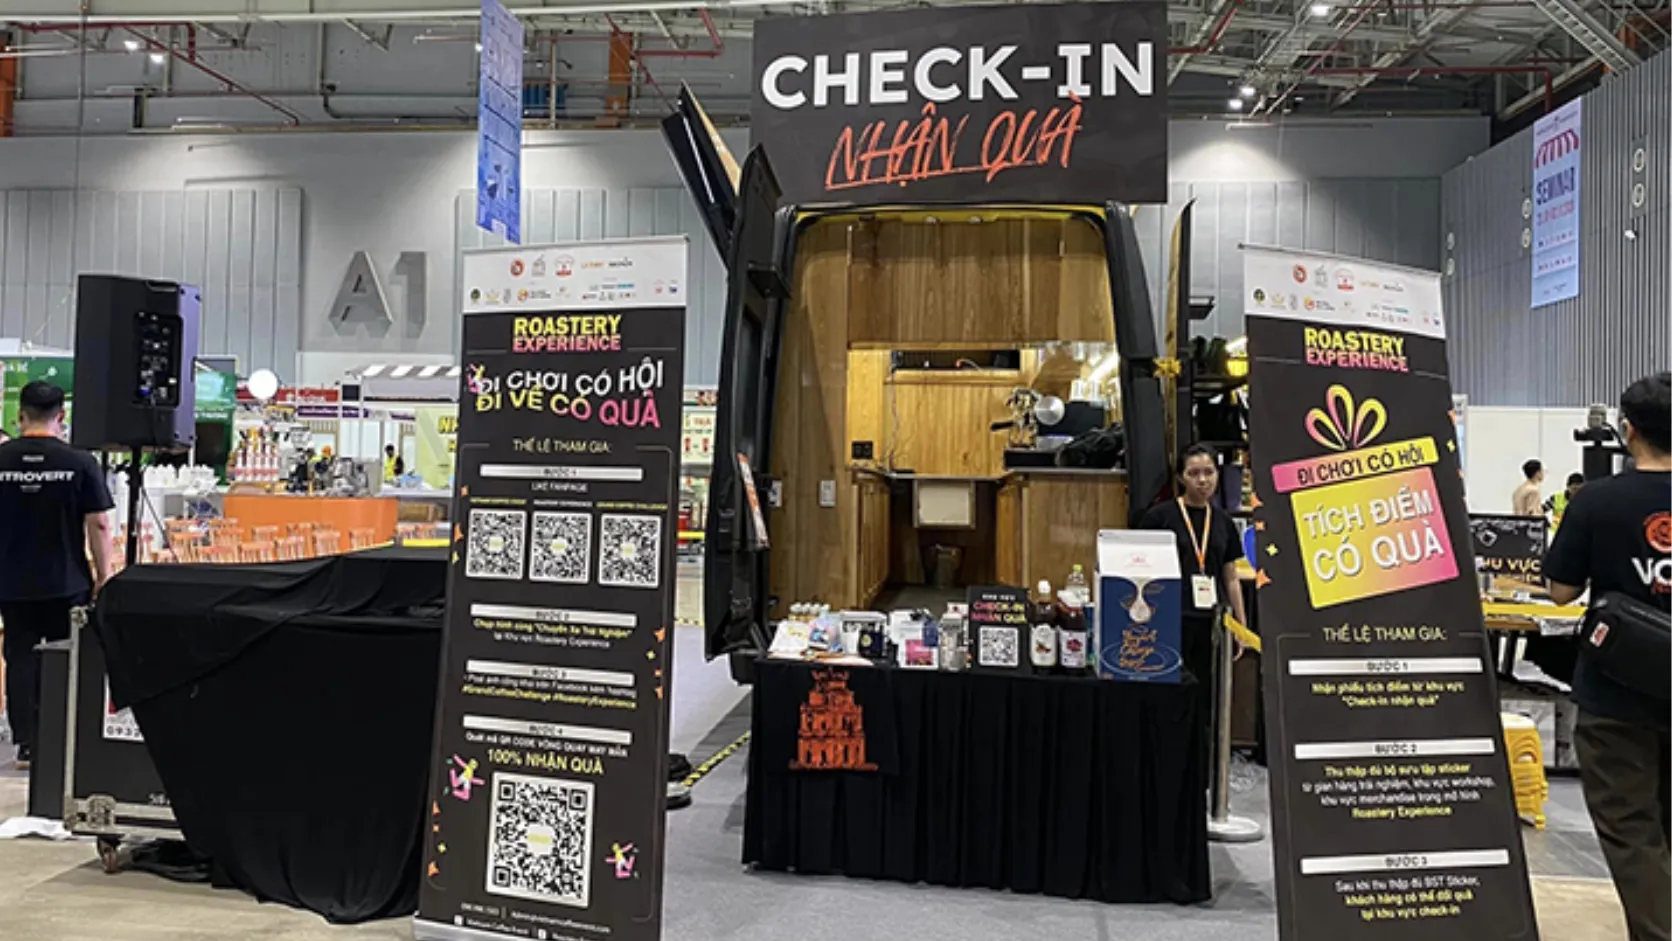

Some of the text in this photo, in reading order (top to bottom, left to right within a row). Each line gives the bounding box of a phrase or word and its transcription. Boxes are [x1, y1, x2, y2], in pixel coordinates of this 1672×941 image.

[762, 42, 1153, 109] CHECK-IN
[825, 90, 1082, 190] NHẬN QUÀ
[328, 251, 427, 339] A1
[514, 315, 622, 336] ROASTERY
[513, 335, 621, 353] EXPERIENCE
[1304, 328, 1404, 356] ROASTERY
[1306, 347, 1409, 372] EXPERIENCE
[506, 371, 568, 393] CHƠI
[575, 369, 612, 396] CÓ
[618, 356, 664, 397] HỘI
[476, 384, 661, 428] ĐI VỀ CÓ QUÀ
[553, 440, 587, 453] THAM
[1297, 442, 1425, 486] ĐI CHƠI CÓ HỘI
[1304, 484, 1434, 539] TÍCH ĐIỂM
[1313, 520, 1445, 582] CÓ QUÀ
[1506, 556, 1542, 573] VỰC
[535, 633, 567, 647] Roastery
[569, 637, 610, 648] Experience
[1323, 626, 1447, 643] THỂ LỆ THAM GIA:
[552, 680, 588, 693] Facebook
[513, 736, 535, 748] CODE
[488, 748, 603, 776] 100% NHẬN QUÀ
[1438, 763, 1470, 774] sticker
[1352, 803, 1452, 820] Roastery Experience
[1424, 874, 1443, 888] BST
[1419, 903, 1461, 916] check-in
